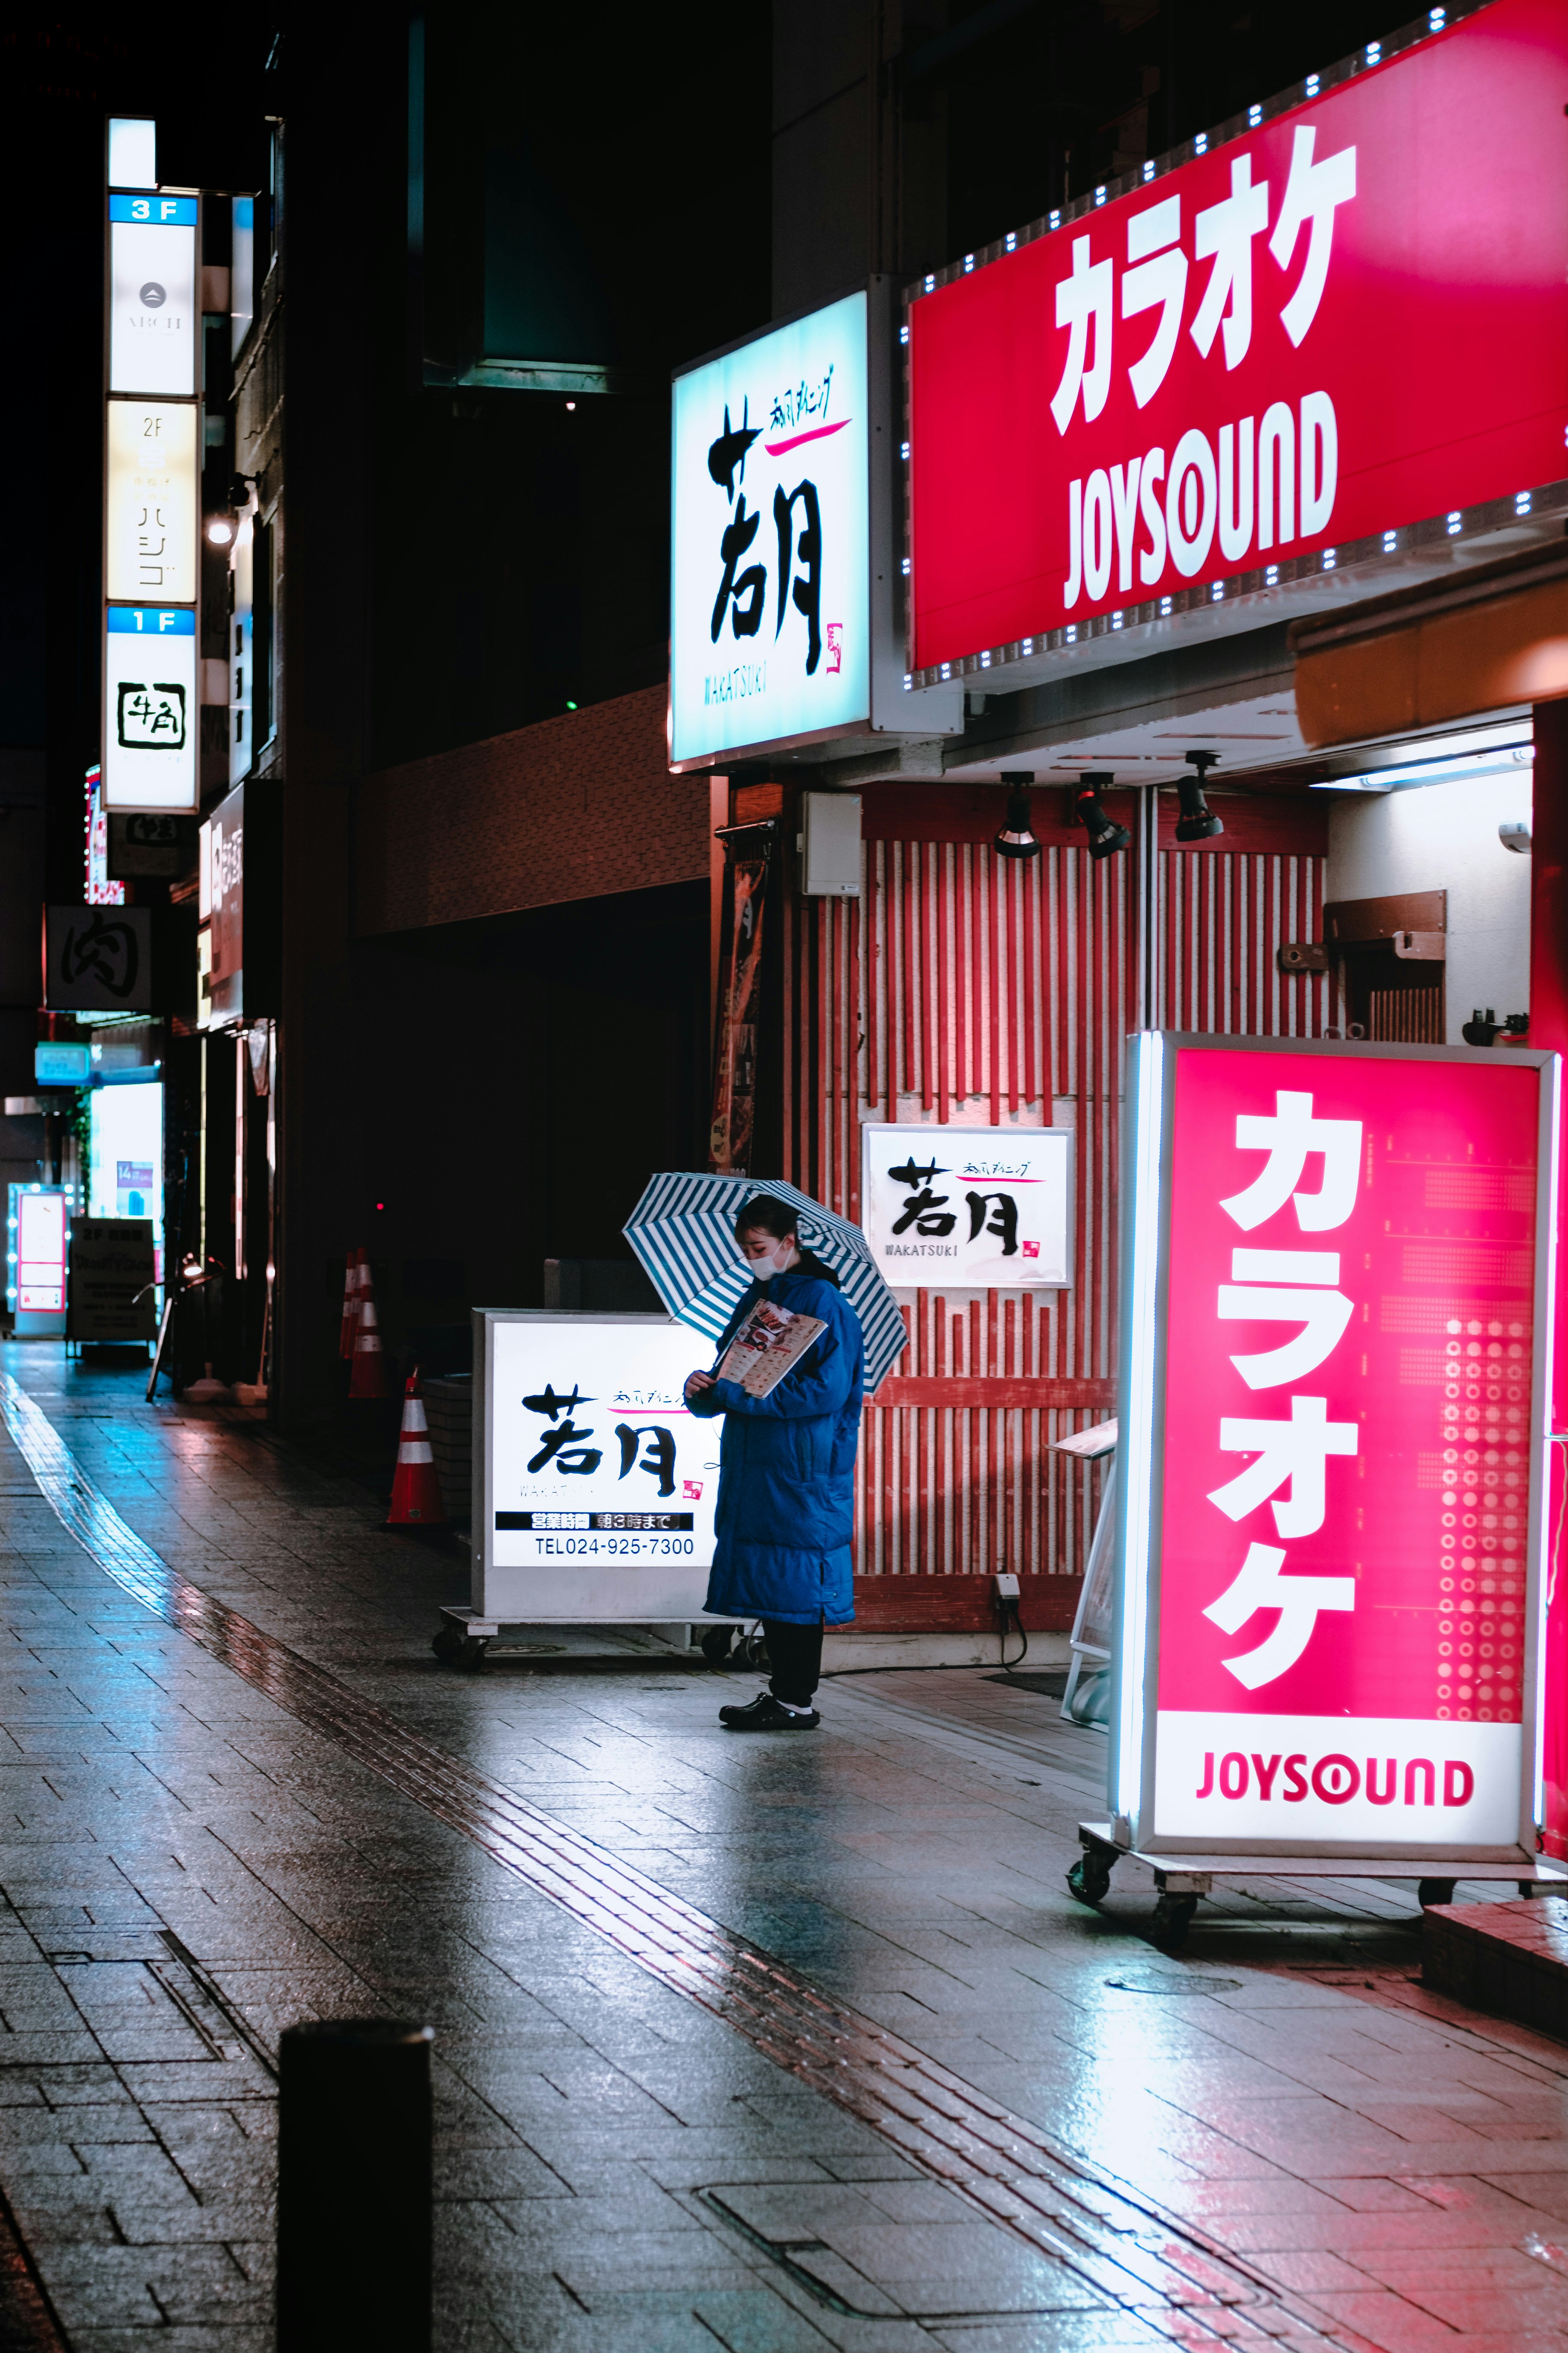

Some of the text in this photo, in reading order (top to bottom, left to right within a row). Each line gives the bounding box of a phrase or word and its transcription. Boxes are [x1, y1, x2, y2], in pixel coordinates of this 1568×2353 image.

[1050, 125, 1356, 436] カラオケ
[144, 417, 163, 437] 2F
[708, 394, 822, 676] 若月
[1064, 390, 1338, 610] JOYSOUND
[138, 508, 175, 585] ハシゴ
[127, 695, 179, 734] 牛角
[888, 1156, 1019, 1256] 若月
[885, 1244, 957, 1257] WAKATSUKI
[1202, 1090, 1363, 1690] カラオケ
[521, 1383, 677, 1498] 若月
[532, 1513, 590, 1530] 営業時間
[535, 1539, 694, 1554] TEL024-925-7300
[1196, 1752, 1475, 1807] JOYSOUND
